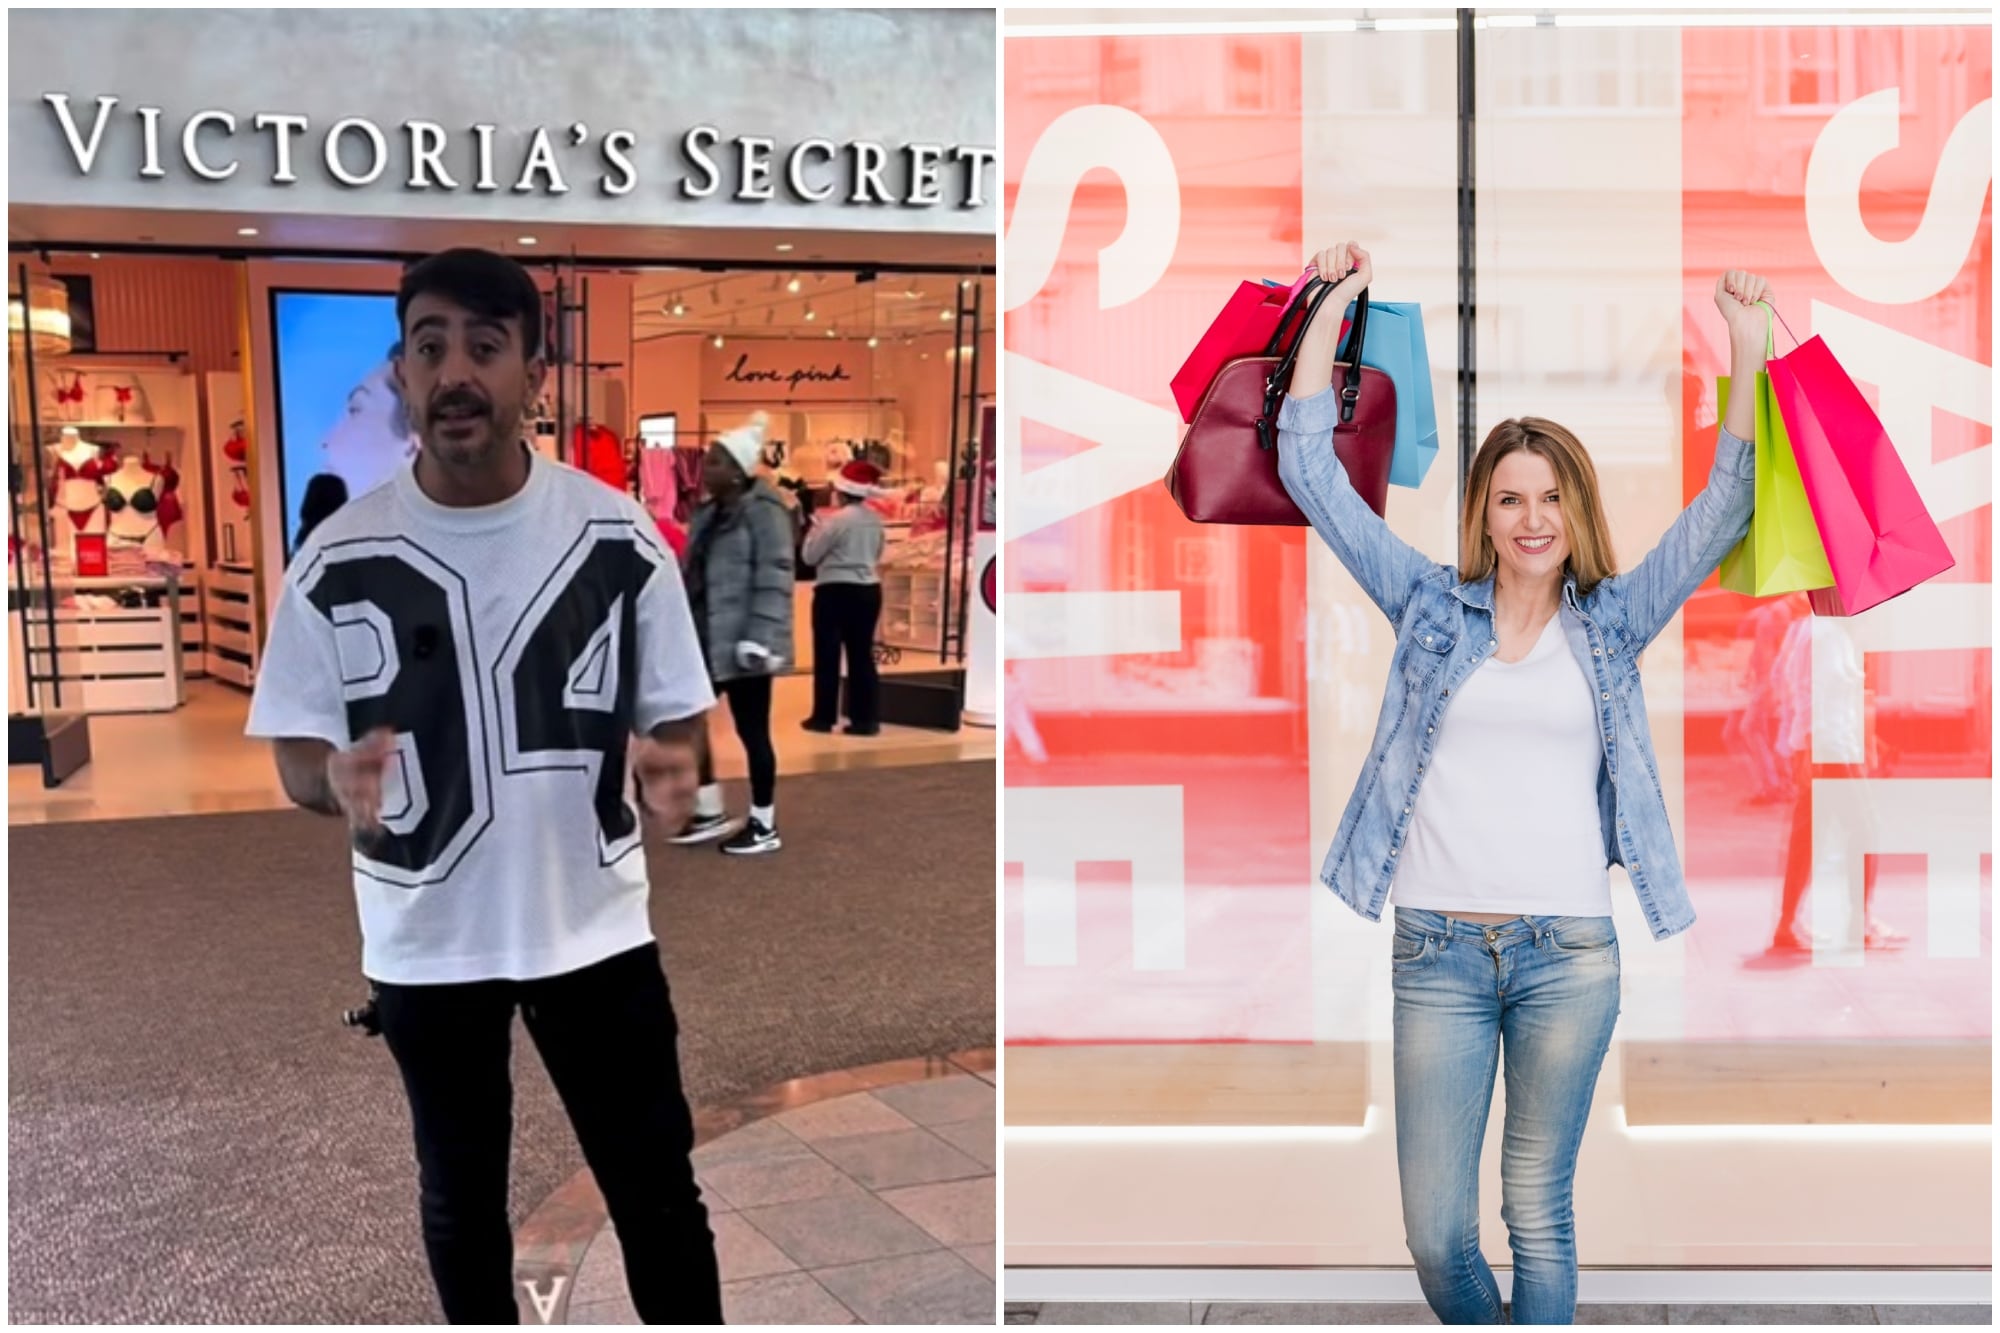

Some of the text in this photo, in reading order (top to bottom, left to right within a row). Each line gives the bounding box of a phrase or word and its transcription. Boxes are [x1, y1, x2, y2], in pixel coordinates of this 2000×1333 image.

[43, 93, 996, 208] VICTORIA'S SECRET
[726, 353, 851, 392] love pink
